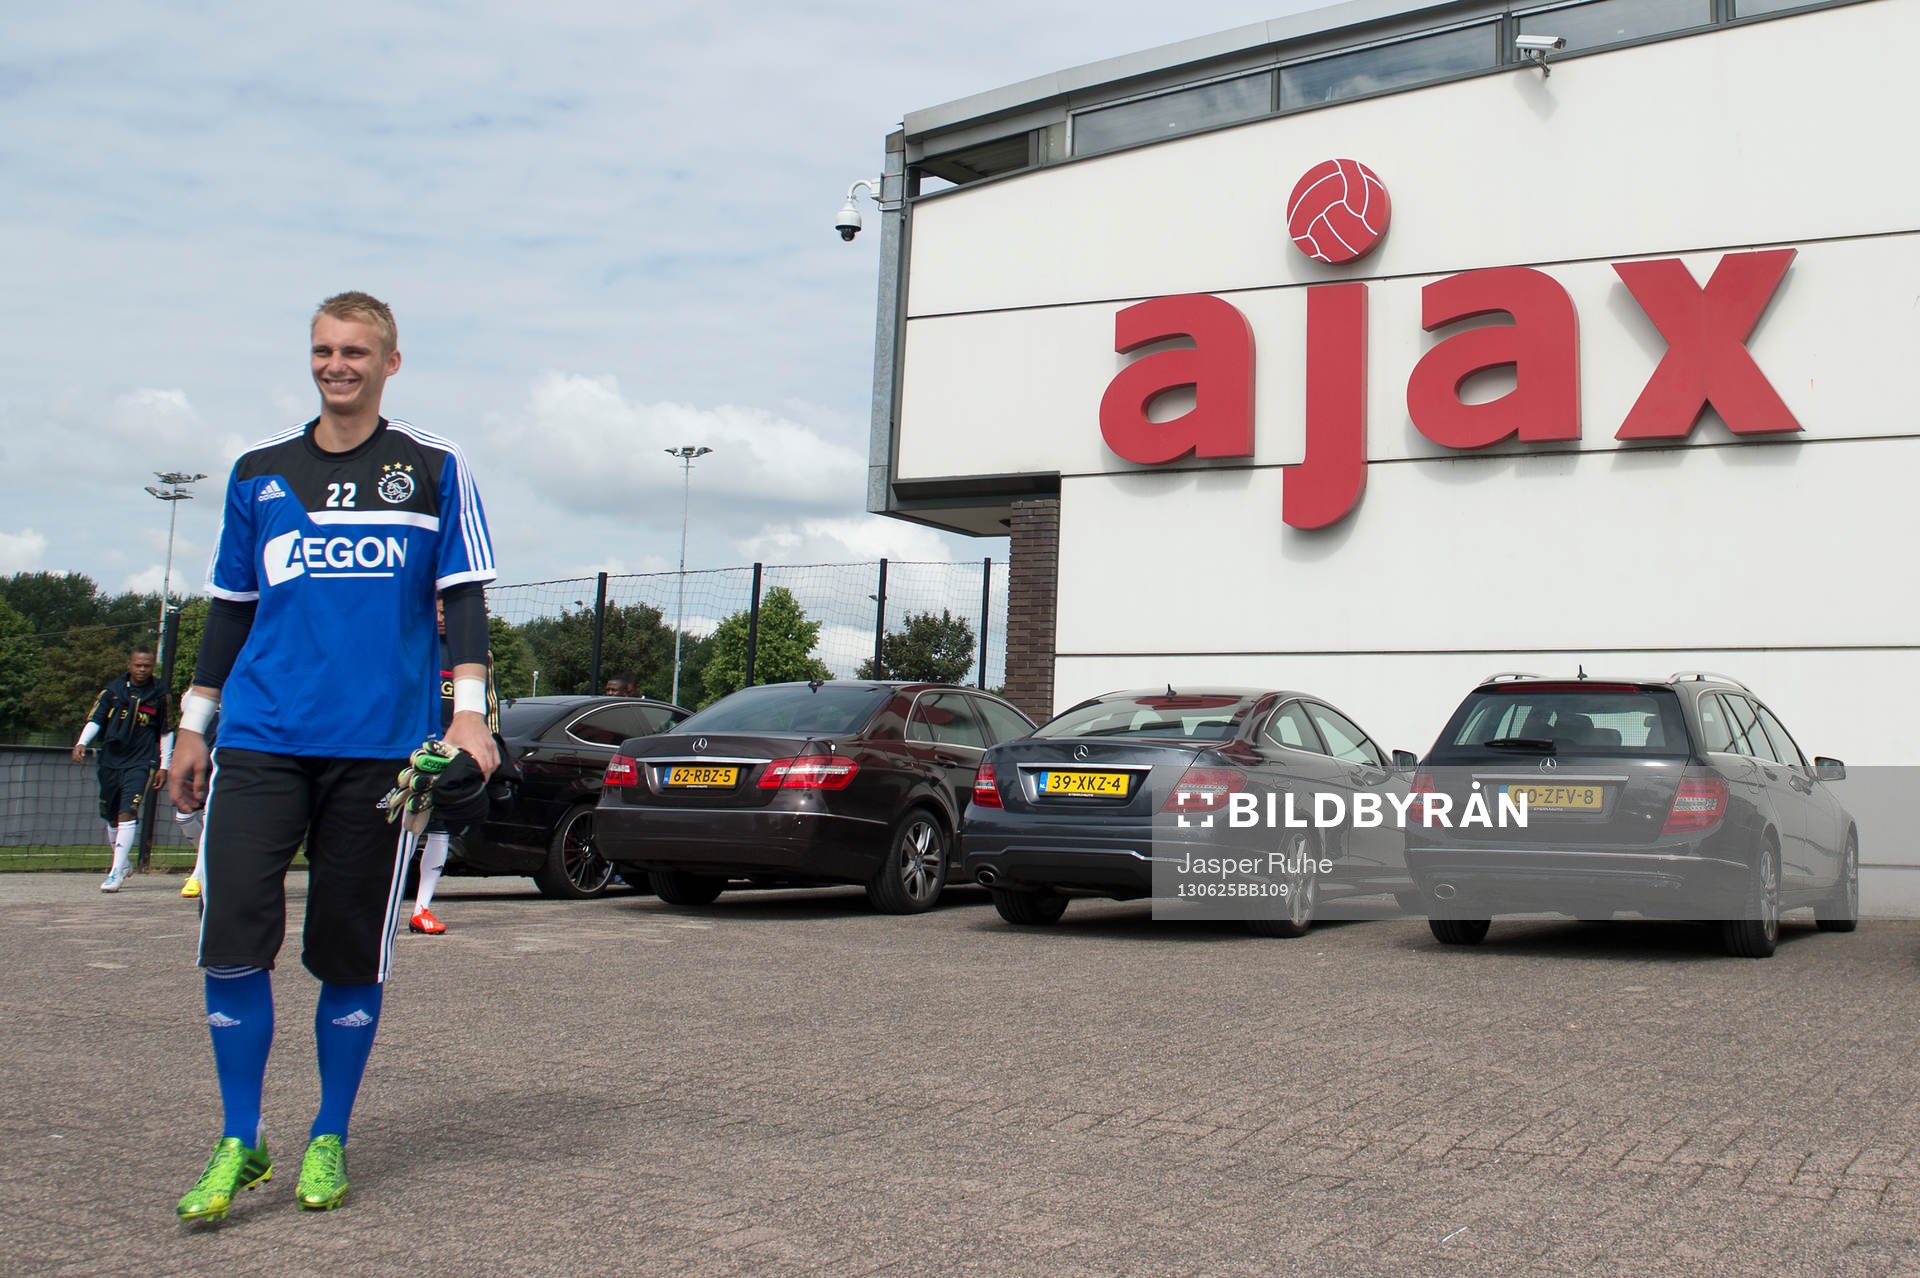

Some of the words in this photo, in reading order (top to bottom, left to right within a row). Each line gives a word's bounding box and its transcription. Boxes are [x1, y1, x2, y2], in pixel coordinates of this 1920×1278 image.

[1099, 159, 1805, 530] ajax
[326, 482, 356, 508] 22
[285, 536, 408, 569] AEGON
[673, 769, 732, 783] 62-RBZ-5
[1052, 775, 1121, 792] 39-XKZ-4
